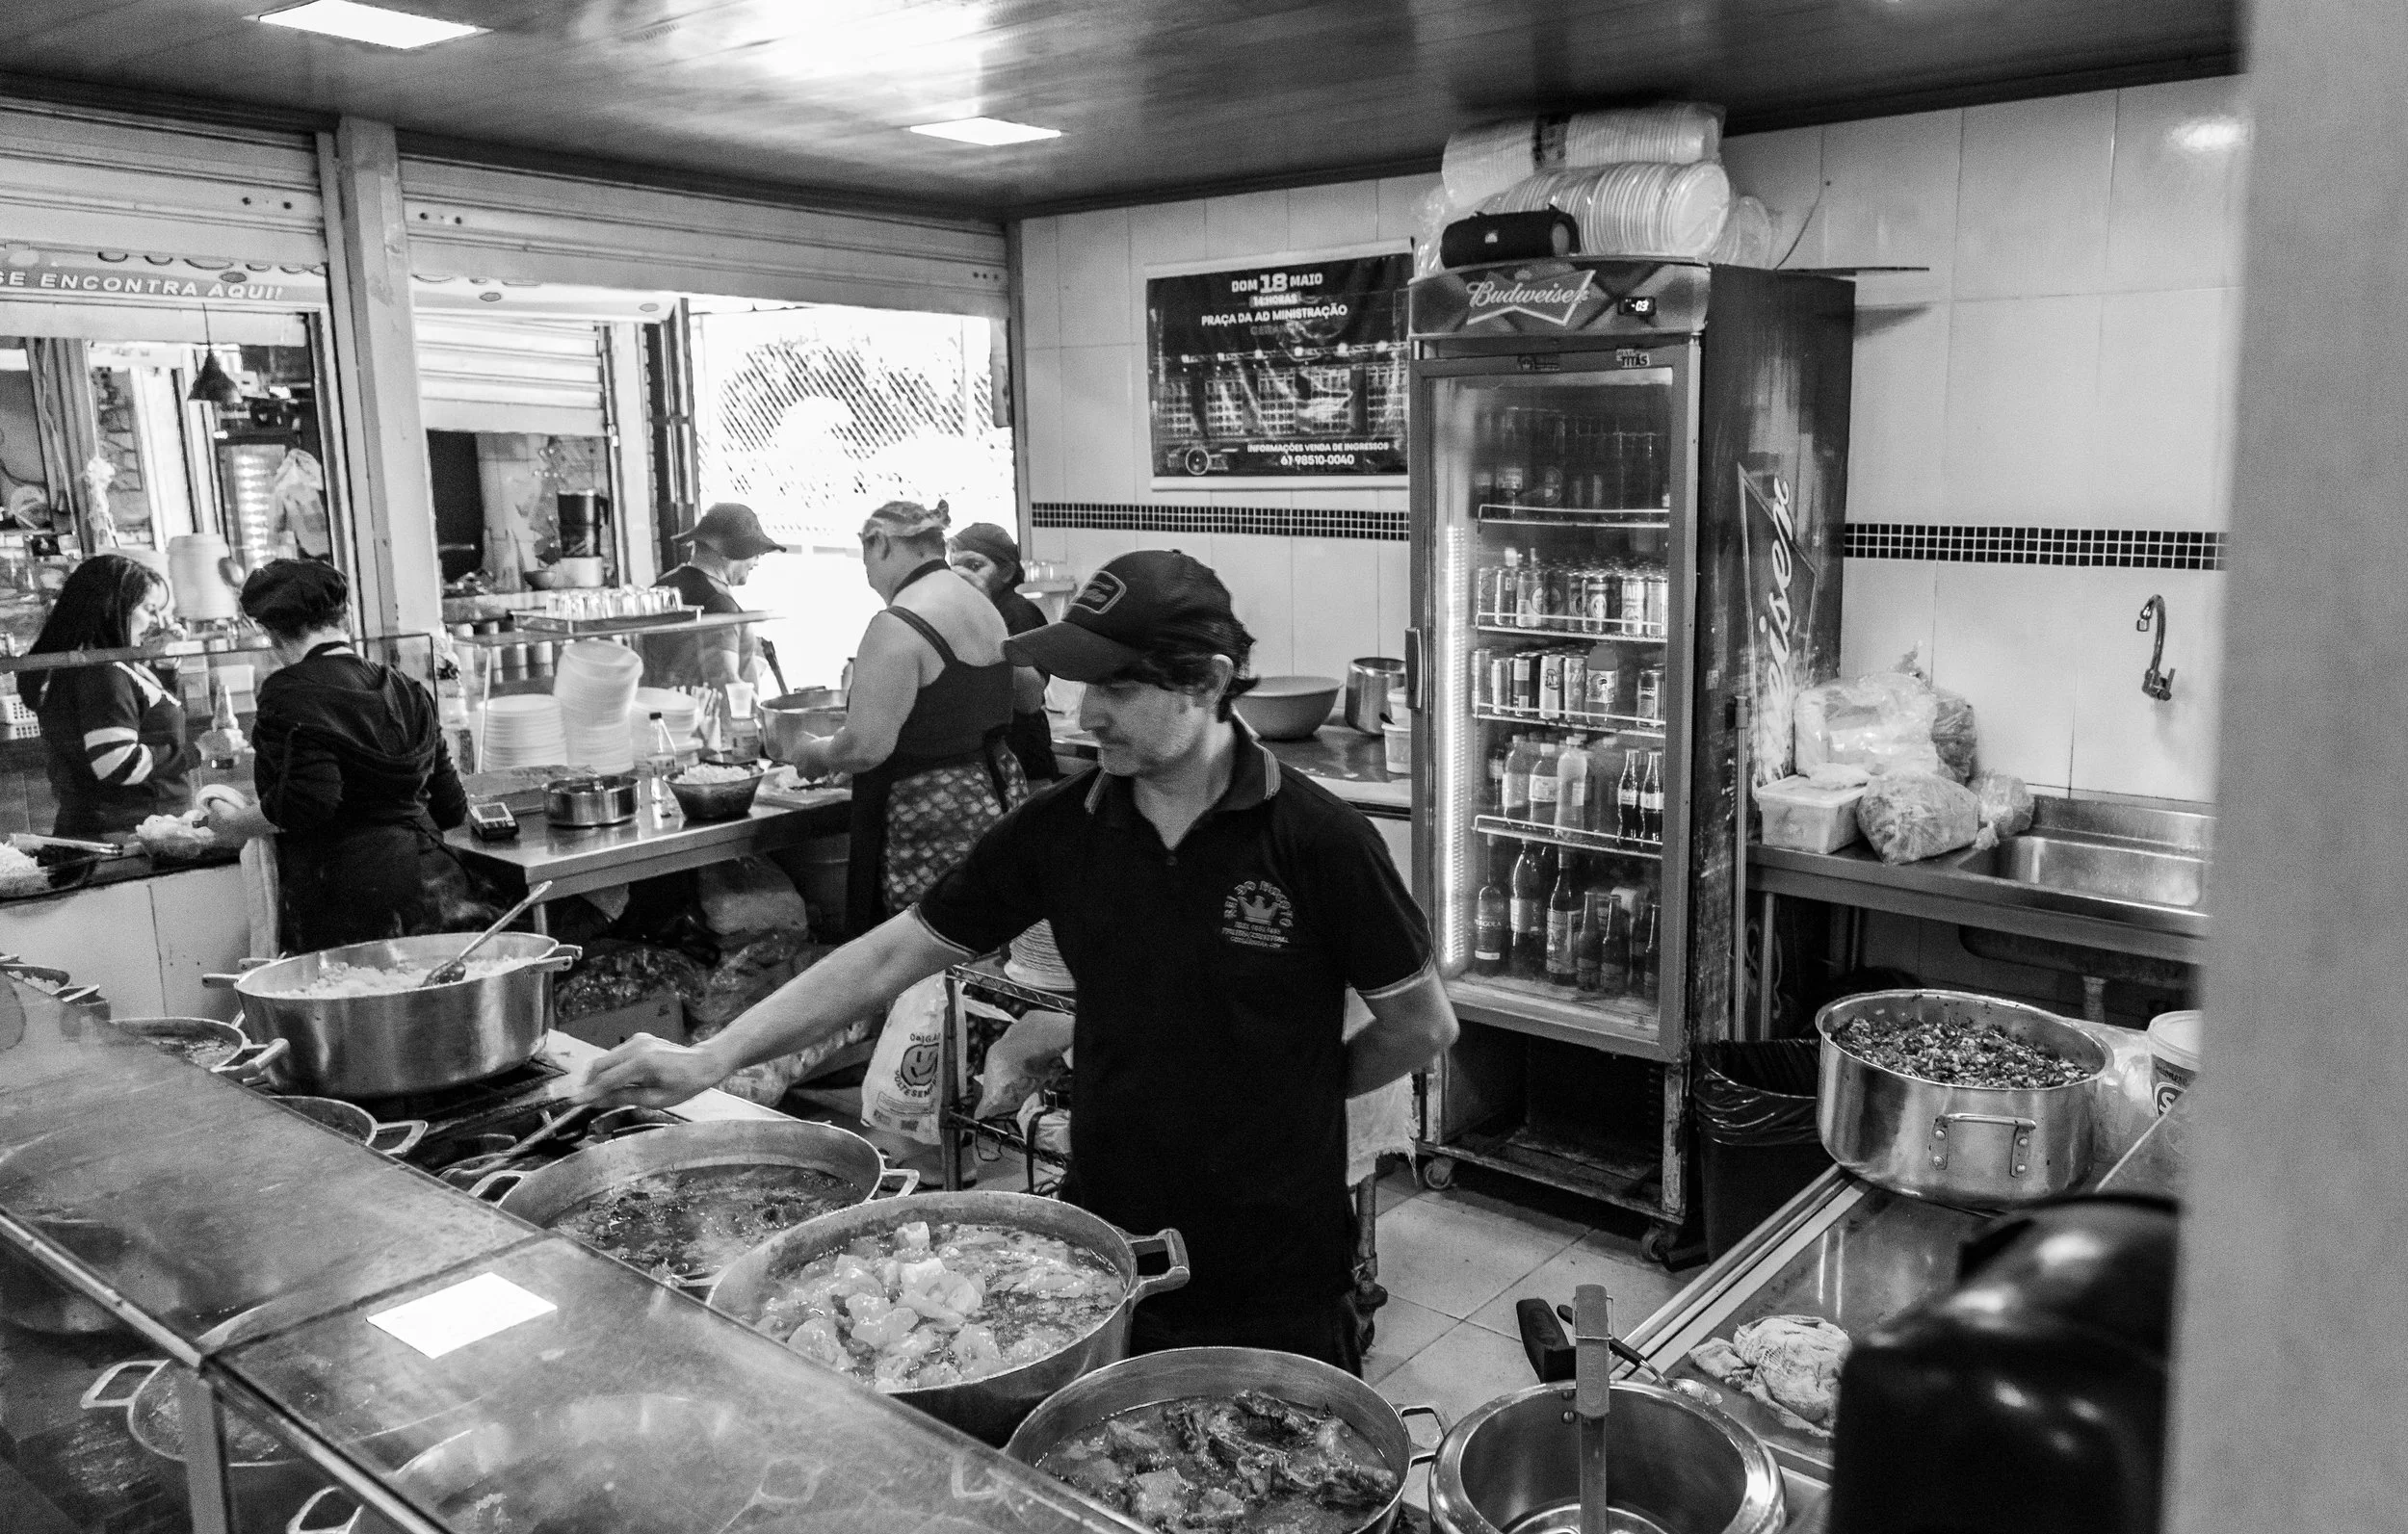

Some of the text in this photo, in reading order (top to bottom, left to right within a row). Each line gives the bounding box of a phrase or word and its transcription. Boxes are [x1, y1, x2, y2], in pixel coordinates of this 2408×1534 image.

[40, 273, 197, 297] ENCONTRA
[1231, 273, 1323, 294] DOM 18 MAIO
[1466, 281, 1590, 307] Budweiser
[1201, 313, 1237, 326] PRAÇA
[1238, 312, 1253, 324] DA
[1247, 442, 1389, 455] INFORMAÇÕES VENDA DE INGRESSOS
[1295, 454, 1355, 466] 98510-0040
